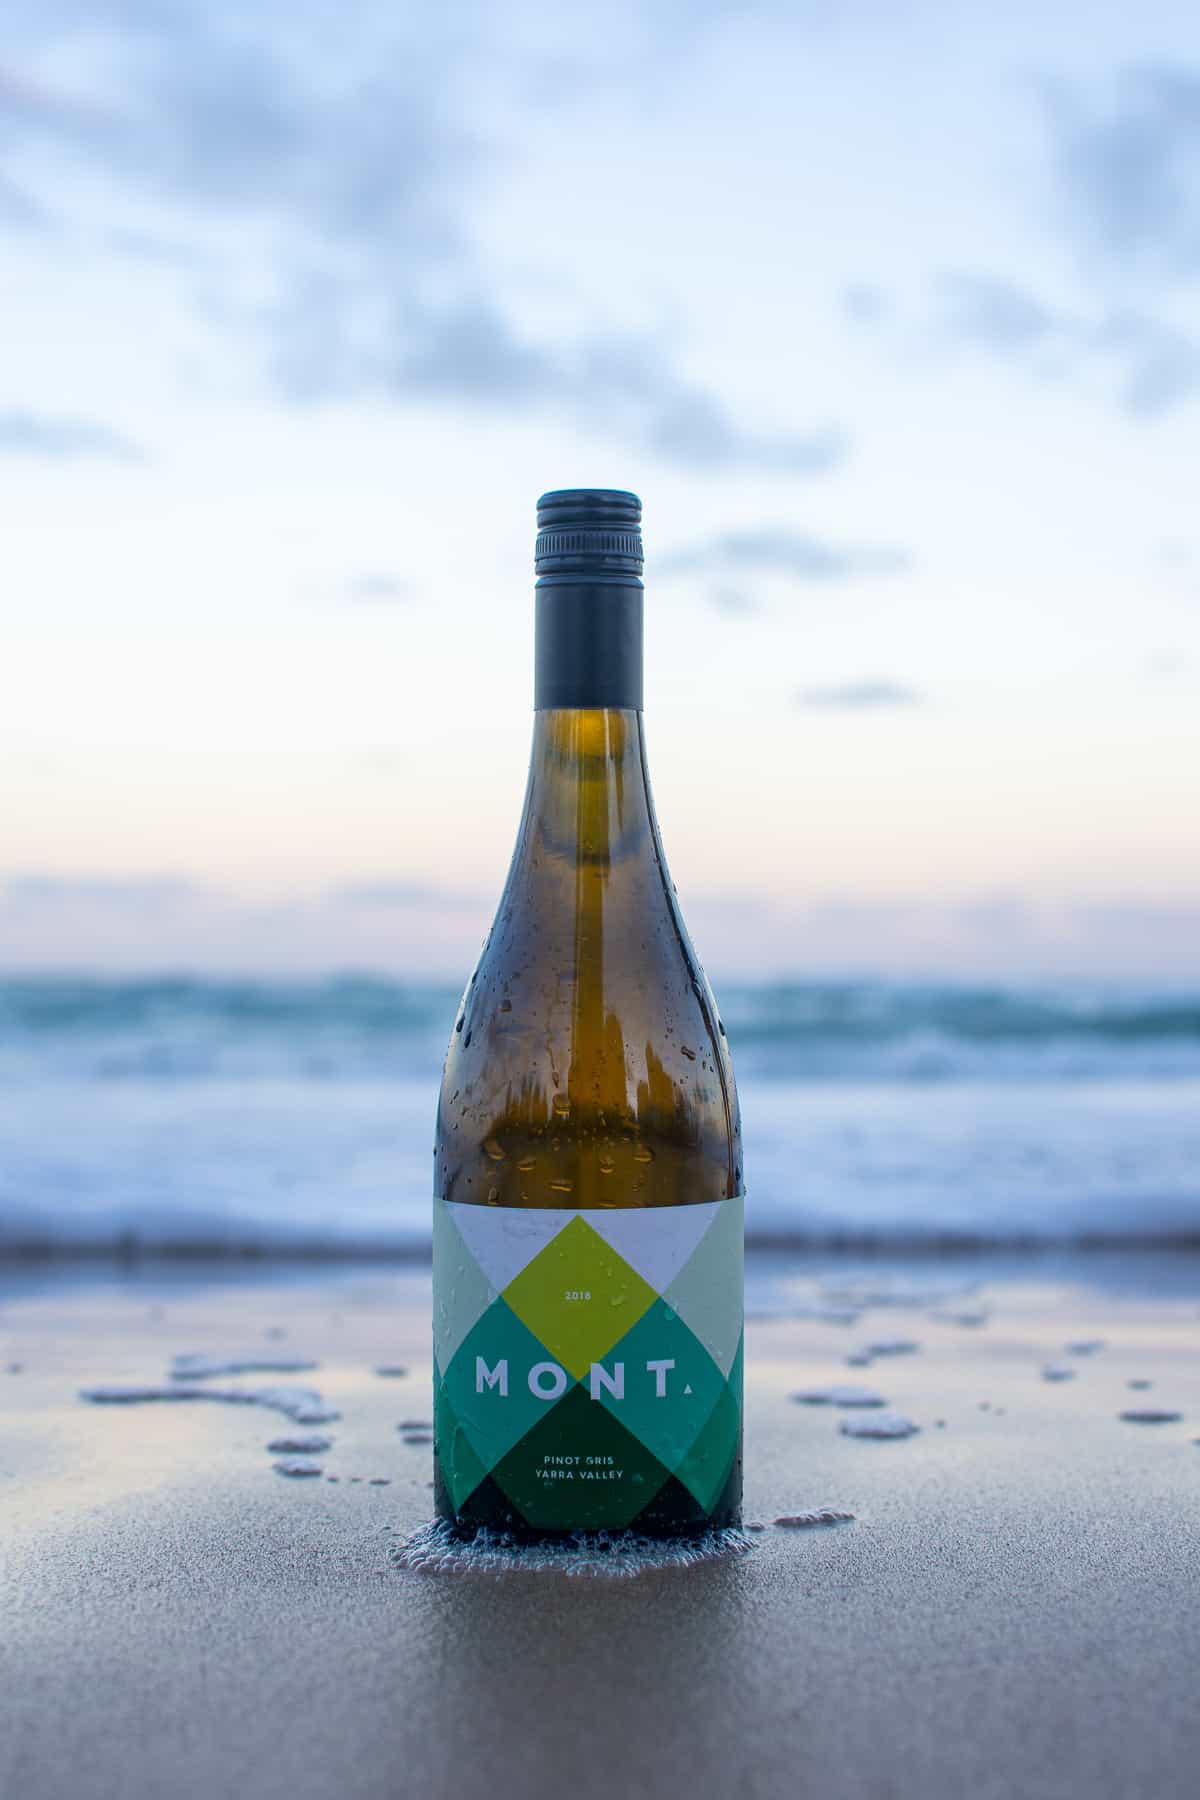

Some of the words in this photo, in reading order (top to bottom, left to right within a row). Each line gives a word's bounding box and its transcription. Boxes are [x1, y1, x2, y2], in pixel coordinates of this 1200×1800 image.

[543, 1455, 580, 1465] PINOT
[585, 1456, 614, 1465] GRIS
[535, 1469, 574, 1479] YARRA
[579, 1470, 624, 1480] VALLEY
